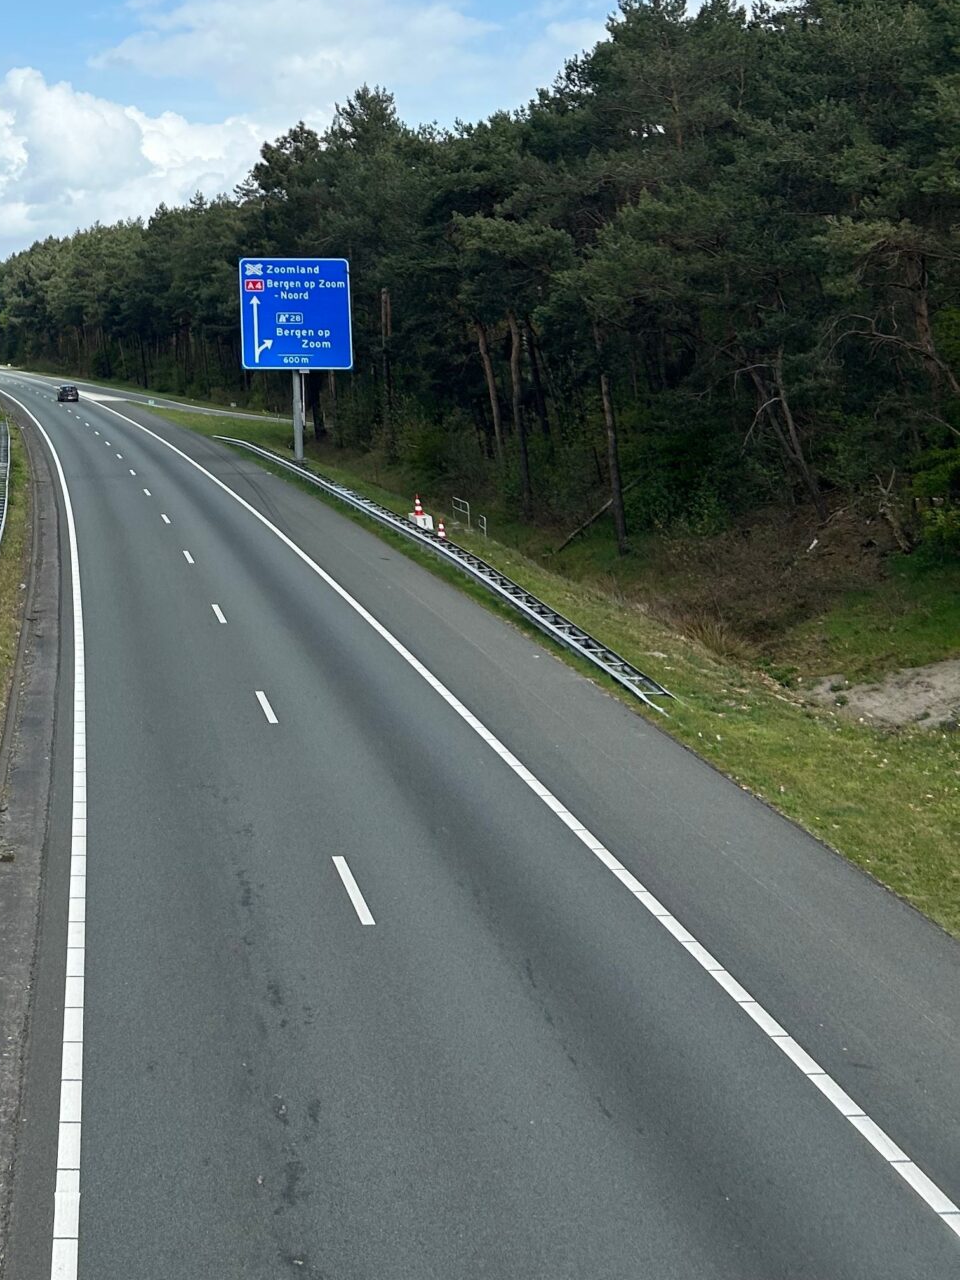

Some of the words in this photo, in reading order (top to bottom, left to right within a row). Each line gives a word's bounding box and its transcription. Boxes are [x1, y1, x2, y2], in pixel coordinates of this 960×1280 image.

[266, 265, 320, 274] Zoomland
[266, 280, 301, 290] Bergen
[304, 281, 316, 289] op
[318, 280, 345, 288] Zoom
[276, 328, 314, 338] Bergen
[317, 329, 330, 337] op
[301, 339, 331, 348] Zoom
